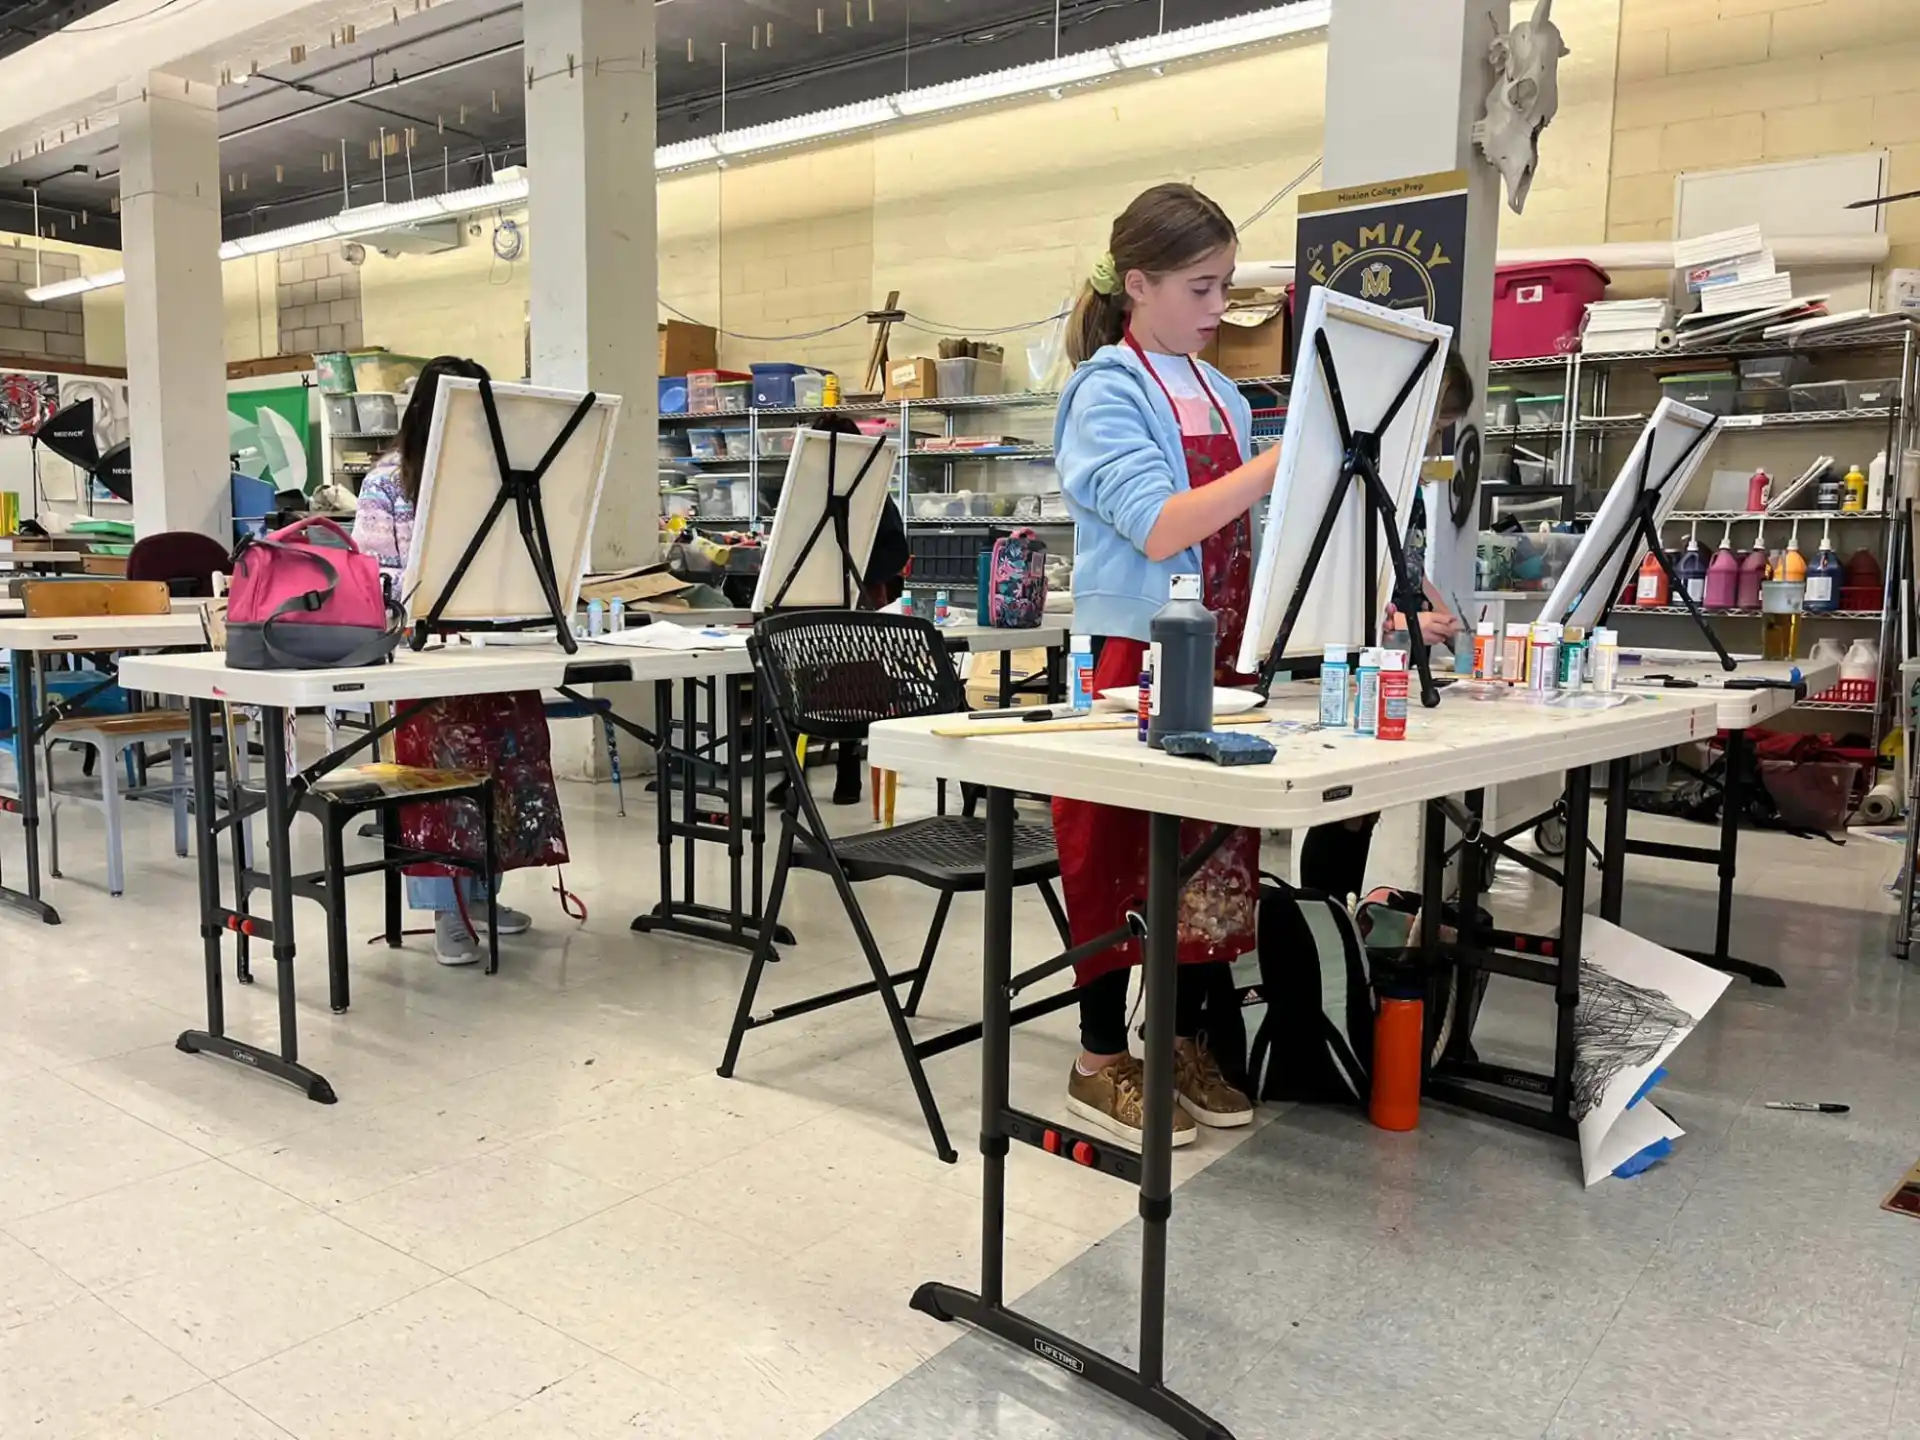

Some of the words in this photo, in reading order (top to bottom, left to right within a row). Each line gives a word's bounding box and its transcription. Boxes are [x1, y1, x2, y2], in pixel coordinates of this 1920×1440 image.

[1338, 191, 1369, 203] Mission
[1371, 186, 1402, 197] College
[1404, 183, 1425, 192] Prep
[1308, 222, 1452, 283] FAMILY
[1039, 1342, 1078, 1369] LIFETIME
